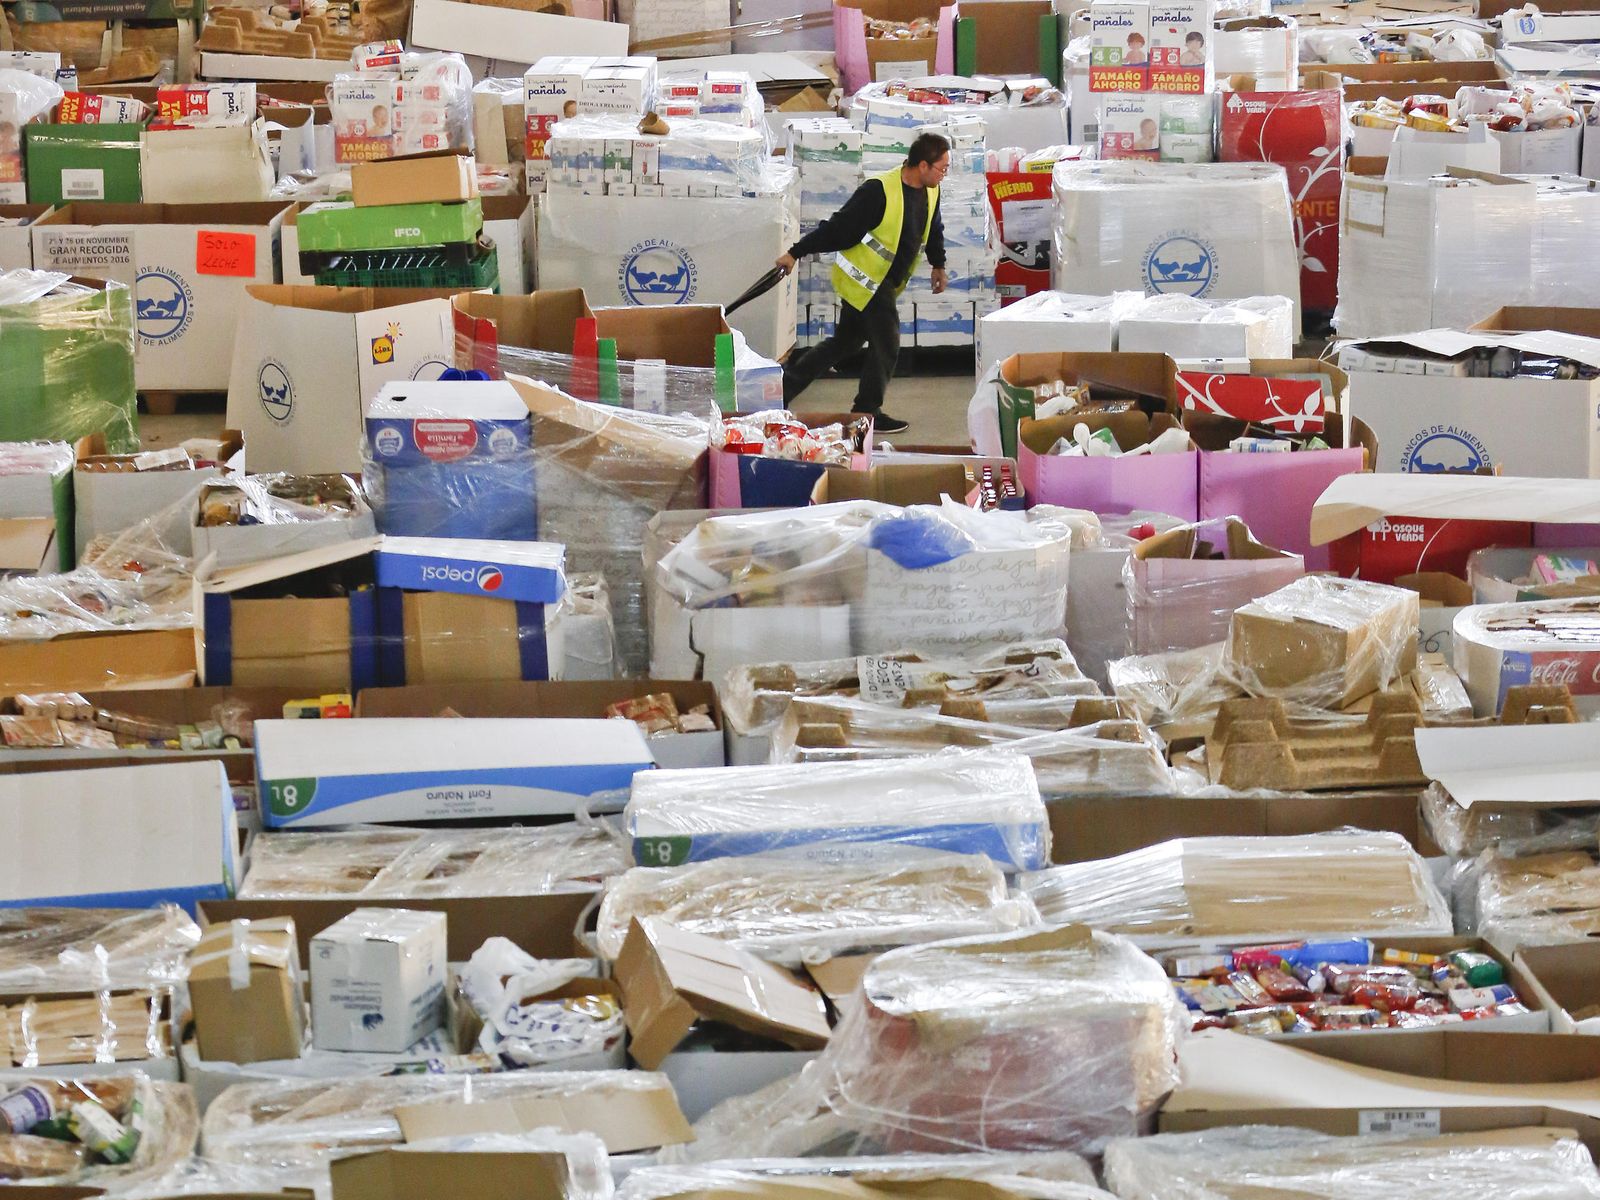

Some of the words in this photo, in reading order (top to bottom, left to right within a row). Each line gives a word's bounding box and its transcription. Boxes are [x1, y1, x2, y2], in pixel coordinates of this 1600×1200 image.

[62, 6, 92, 14] Natural
[93, 5, 123, 13] Mineral
[125, 3, 146, 12] Agua
[1093, 16, 1133, 31] pañales
[1152, 11, 1192, 27] pañales
[1094, 51, 1104, 62] 4
[1152, 51, 1162, 62] 5
[1093, 70, 1142, 81] TAMAÑO
[1152, 71, 1200, 83] TAMAÑO
[1093, 81, 1141, 90] AHORRO
[1152, 83, 1200, 92] AHORRO
[528, 84, 567, 100] pañales
[86, 95, 99, 108] 3
[190, 94, 204, 105] 5
[1106, 104, 1145, 117] pañales
[529, 119, 539, 131] 3
[341, 141, 388, 151] TAMAÑO
[1106, 136, 1116, 148] 3
[994, 180, 1034, 200] HIERRO
[394, 227, 421, 238] IFCO
[86, 236, 129, 244] NOVIEMBRE
[644, 238, 657, 247] DE
[49, 246, 77, 255] GRAN
[79, 245, 130, 255] RECOGIDA
[62, 256, 108, 264] ALIMENTOS
[110, 255, 130, 264] 2016
[141, 265, 152, 273] DE
[155, 265, 194, 302] ALIMENTOS
[143, 338, 155, 346] DE
[158, 311, 194, 347] ALIMENTOS
[374, 345, 392, 355] LIDL
[1400, 429, 1429, 465] BANCOS
[1430, 424, 1444, 434] DE
[1447, 425, 1492, 467] ALIMENTOS
[1395, 532, 1425, 542] VERDE
[421, 564, 475, 582] pepsi
[426, 790, 464, 801] Natura
[467, 789, 492, 800] Font
